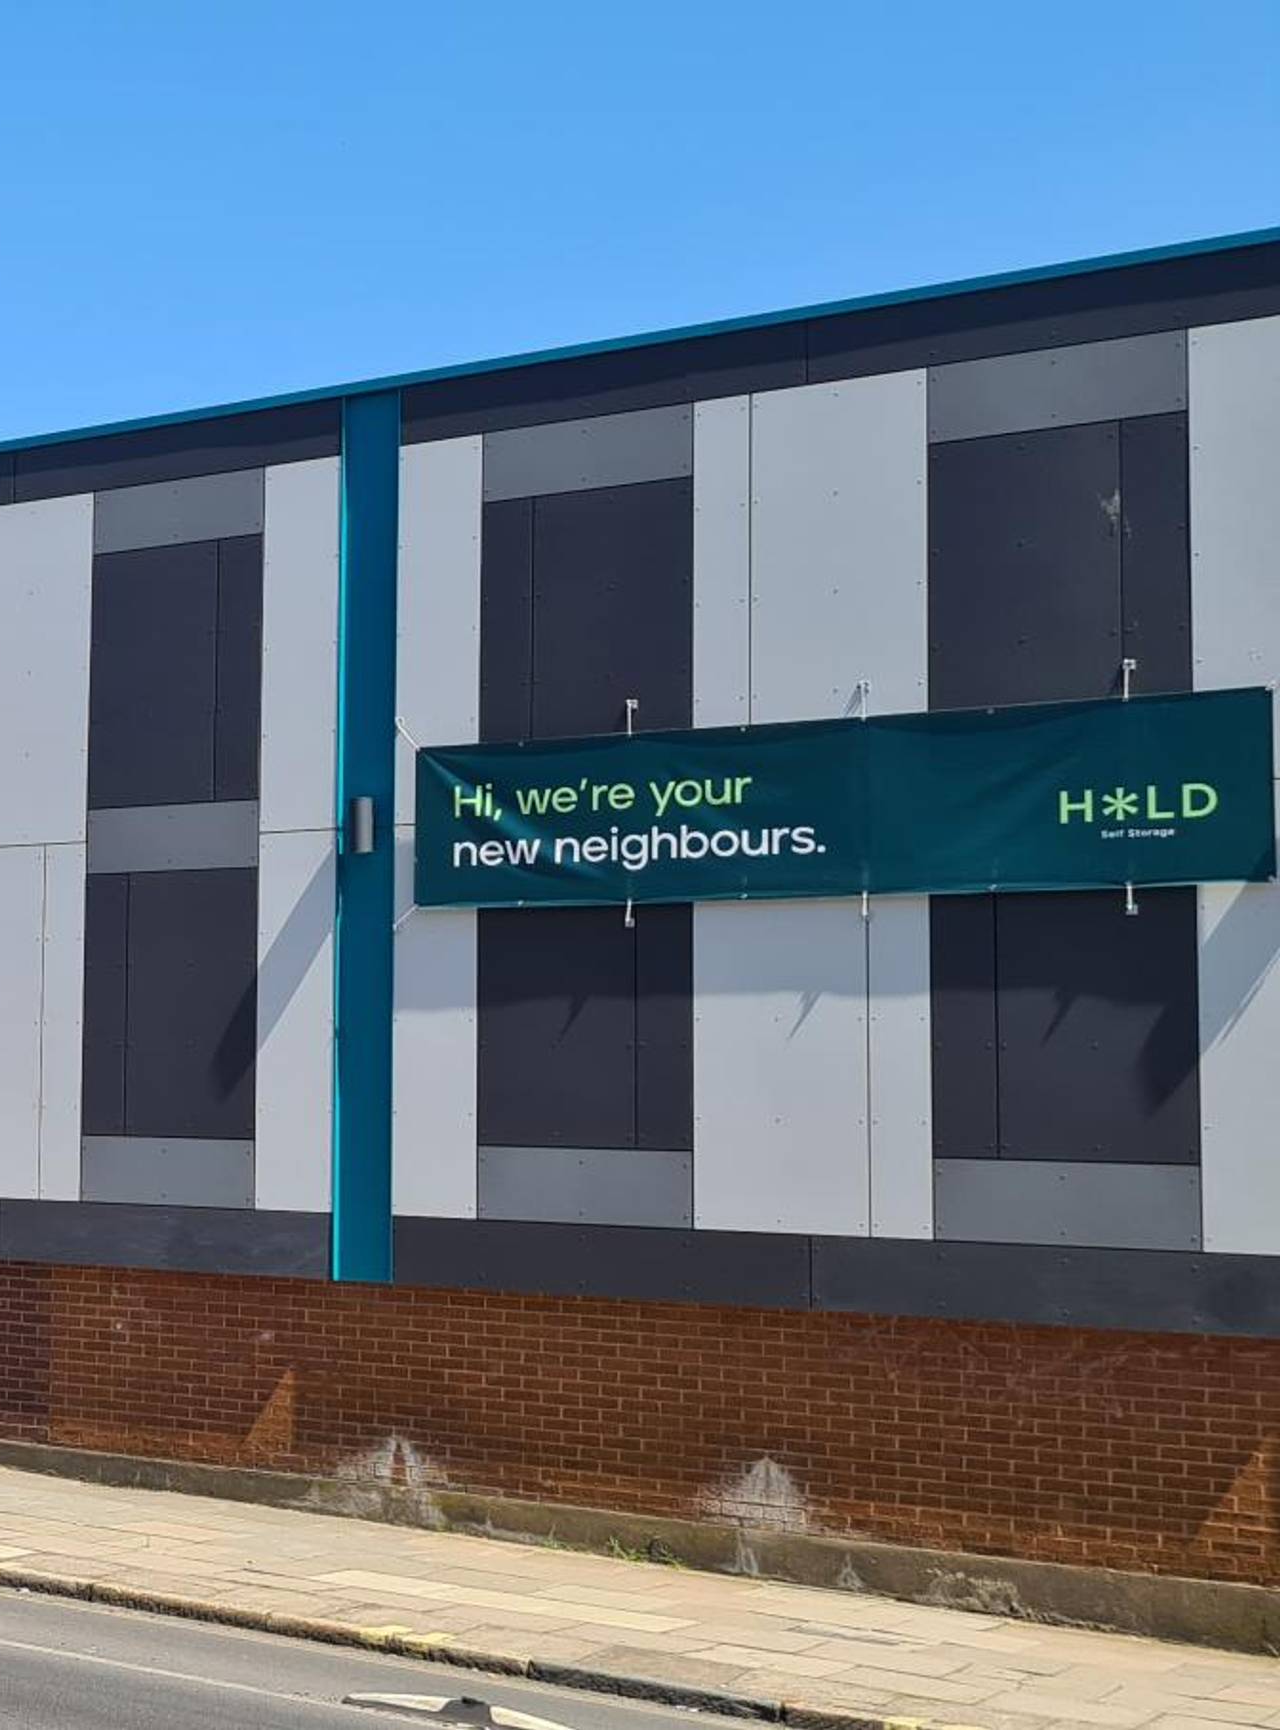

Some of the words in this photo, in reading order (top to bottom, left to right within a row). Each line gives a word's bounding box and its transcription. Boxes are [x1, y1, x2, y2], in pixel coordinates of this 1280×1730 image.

[453, 783, 503, 821] Hi,
[516, 777, 636, 815] we're
[648, 775, 753, 818] your
[452, 837, 542, 868] new
[553, 824, 827, 872] neighbours.
[1100, 829, 1125, 839] Self
[1127, 828, 1176, 839] Storage
